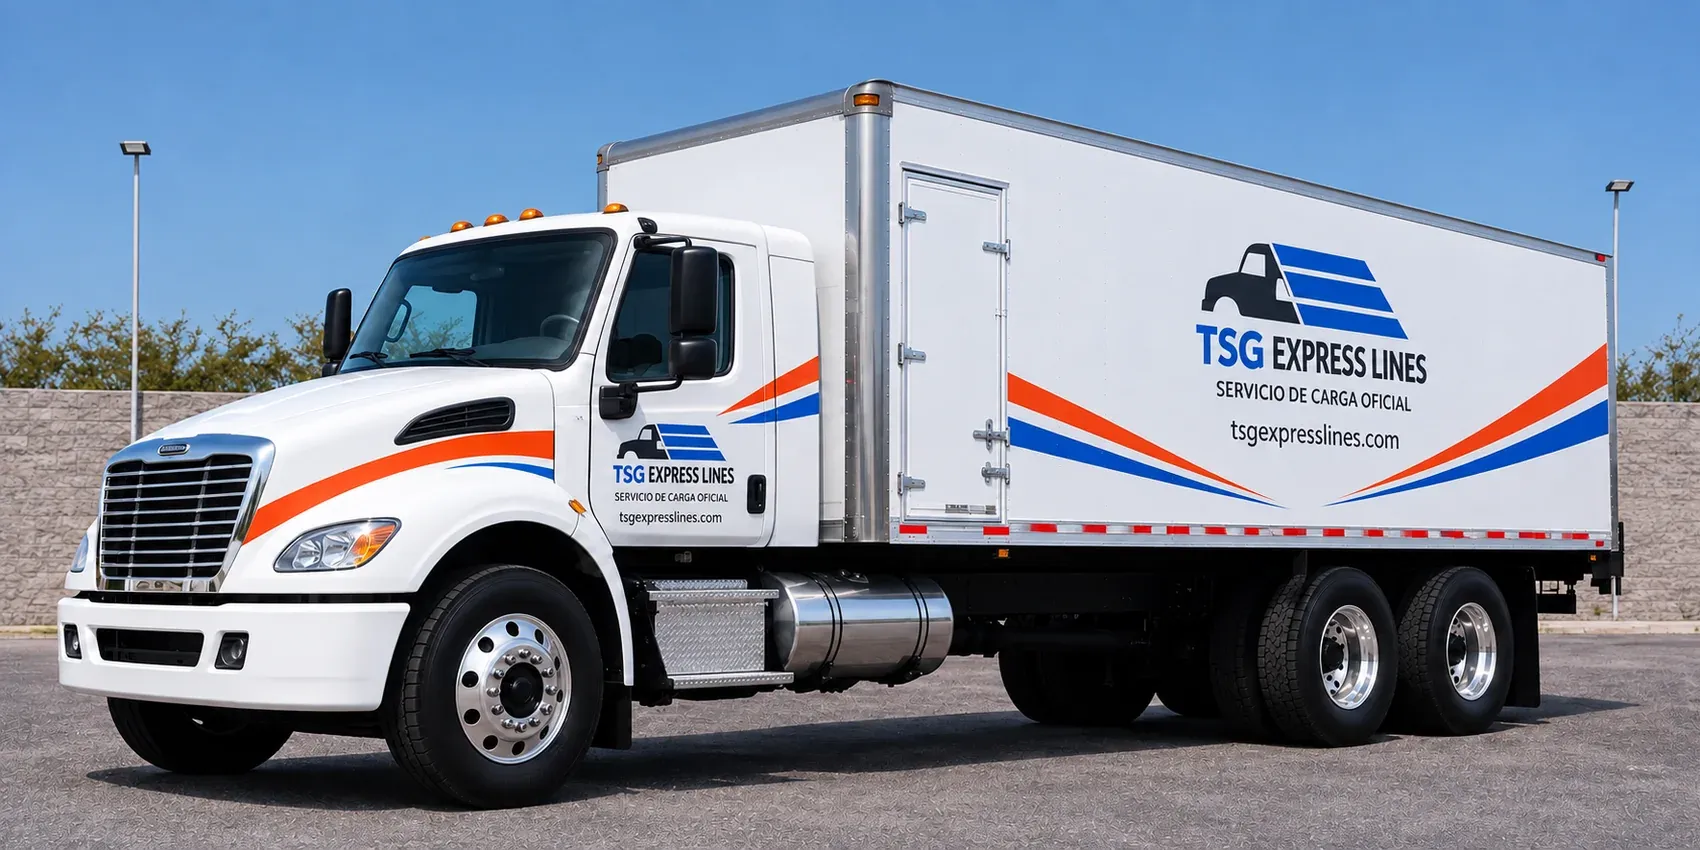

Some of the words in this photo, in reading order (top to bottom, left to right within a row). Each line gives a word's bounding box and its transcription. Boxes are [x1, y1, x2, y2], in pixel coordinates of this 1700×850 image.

[1196, 324, 1264, 370] TSG
[1272, 335, 1367, 378] EXPRESS
[1371, 348, 1427, 385] LINES
[1216, 380, 1285, 402] SERVICIO
[1289, 386, 1307, 404] DE
[1311, 388, 1358, 407] CARGA
[1361, 392, 1412, 412] OFICIAL
[1231, 420, 1399, 450] tsgexpresslines.com
[613, 464, 645, 484] TSG
[649, 466, 699, 484] EXPRESS
[702, 467, 735, 485] LINES
[614, 492, 654, 502] SERVICIO
[655, 492, 666, 502] DE
[668, 493, 696, 502] CARGA
[697, 493, 729, 503] OFICIAL
[619, 511, 722, 526] tsgexpresslines.com
